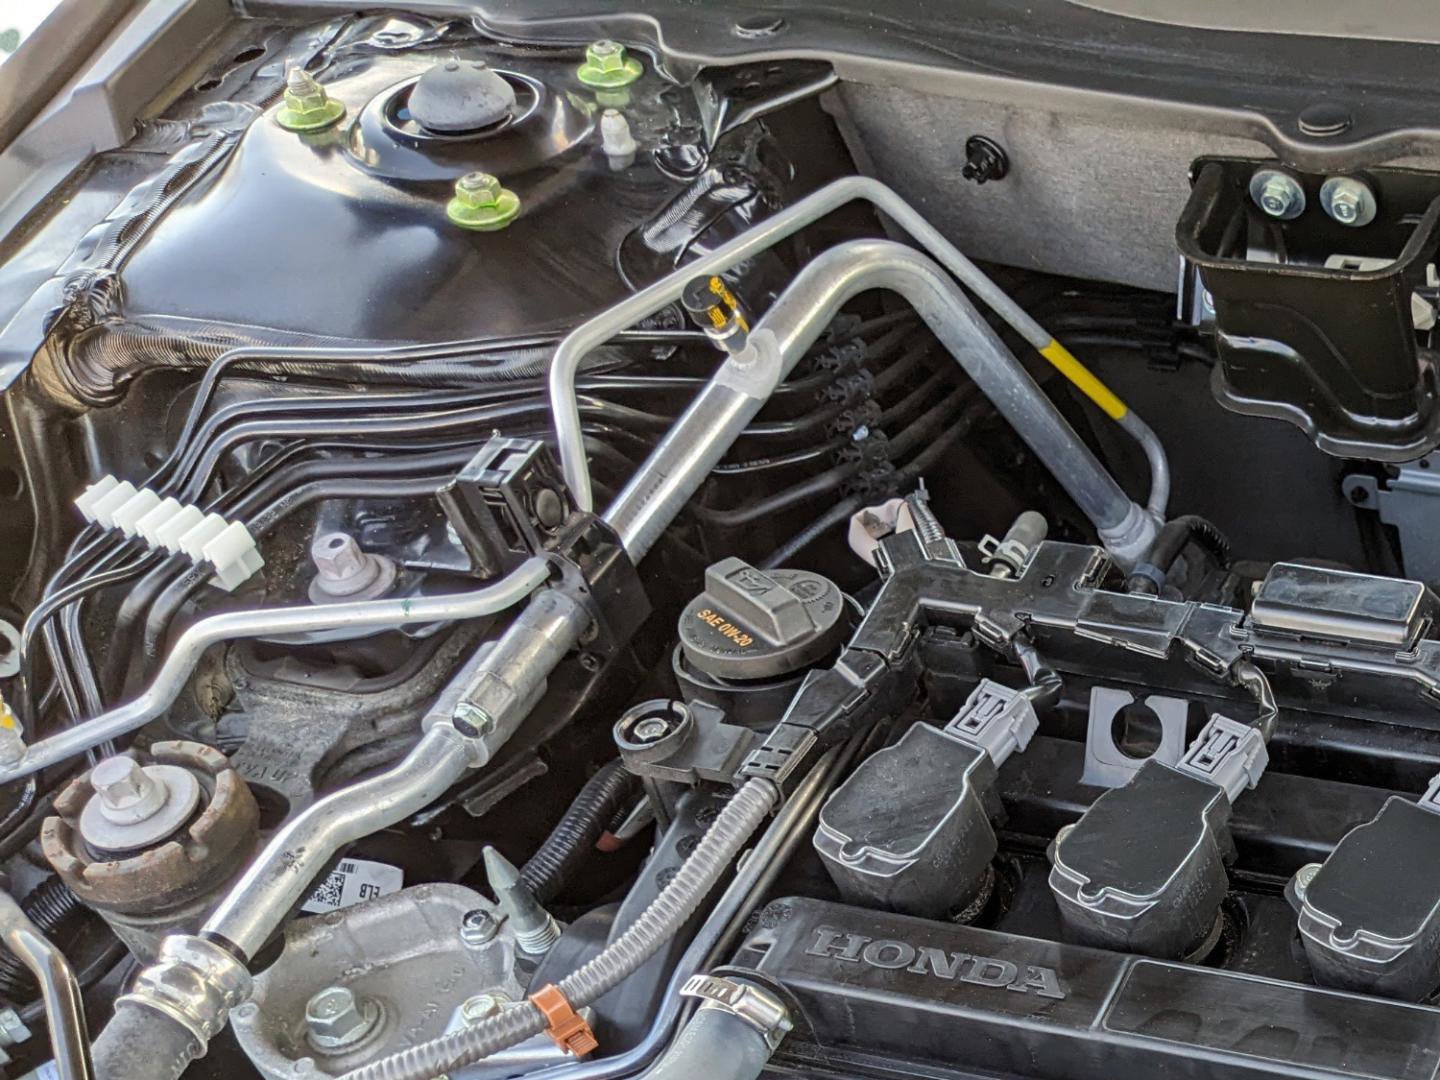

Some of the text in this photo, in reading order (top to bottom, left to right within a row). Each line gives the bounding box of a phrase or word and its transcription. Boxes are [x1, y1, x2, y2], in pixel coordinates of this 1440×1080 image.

[697, 608, 724, 628] SAE
[718, 621, 753, 648] 0W-20
[805, 925, 1066, 1000] HONDA
